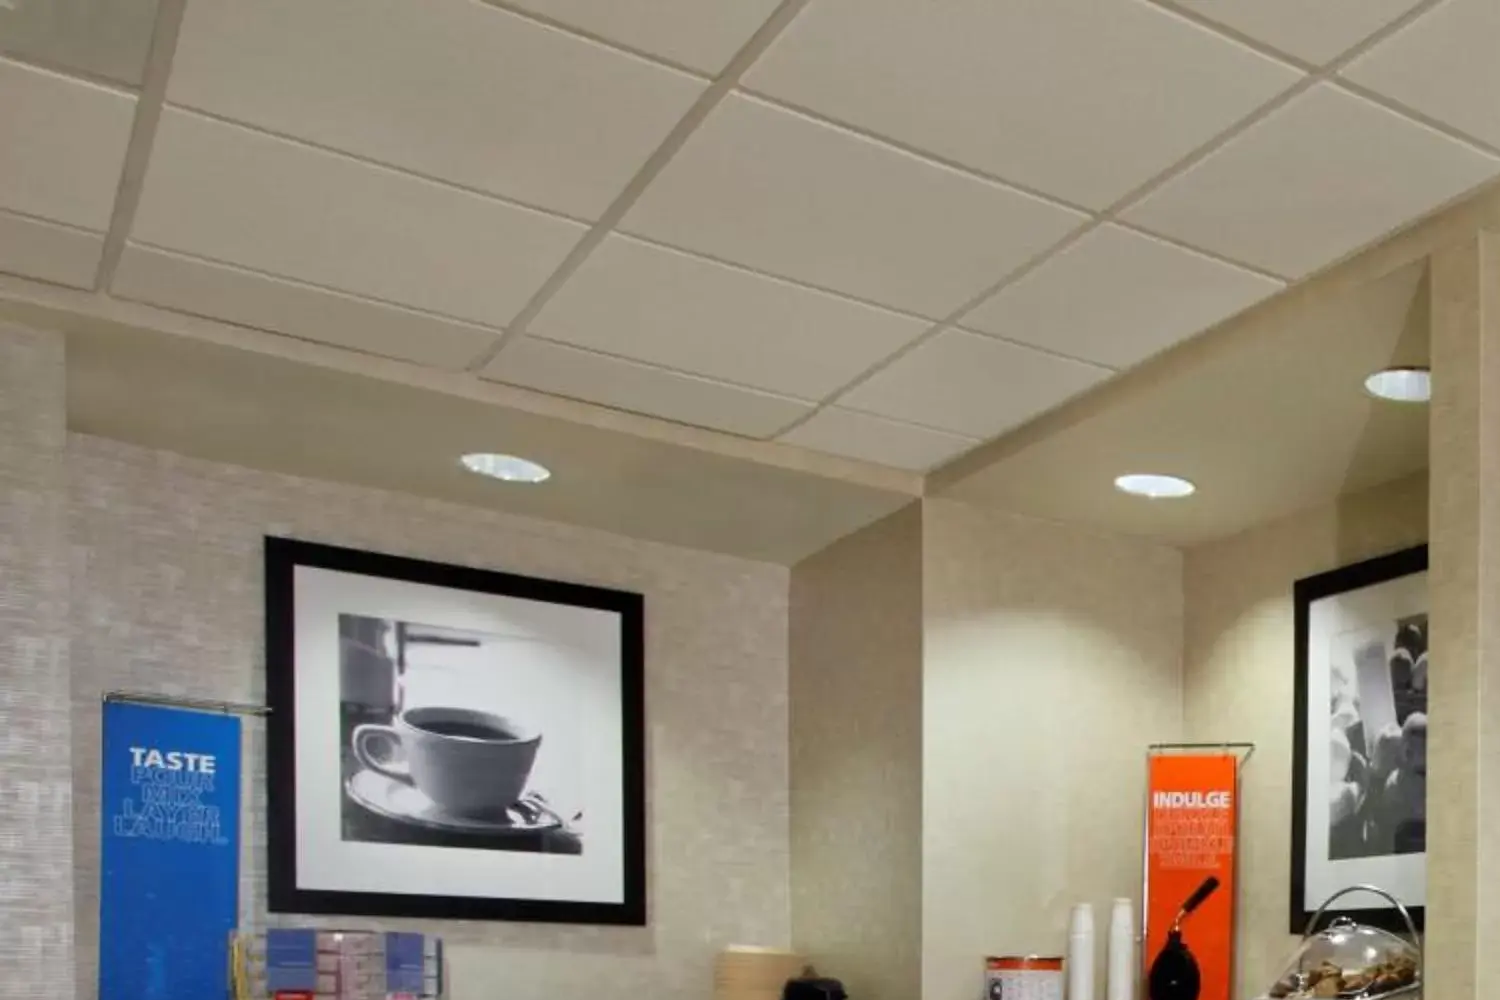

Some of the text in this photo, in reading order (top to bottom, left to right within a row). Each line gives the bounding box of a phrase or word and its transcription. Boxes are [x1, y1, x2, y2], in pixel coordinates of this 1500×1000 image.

[130, 747, 215, 773] TASTE
[131, 764, 214, 791] POUR
[142, 783, 202, 807] MIX
[1153, 790, 1230, 808] INDULGE
[123, 797, 218, 826] LAYER
